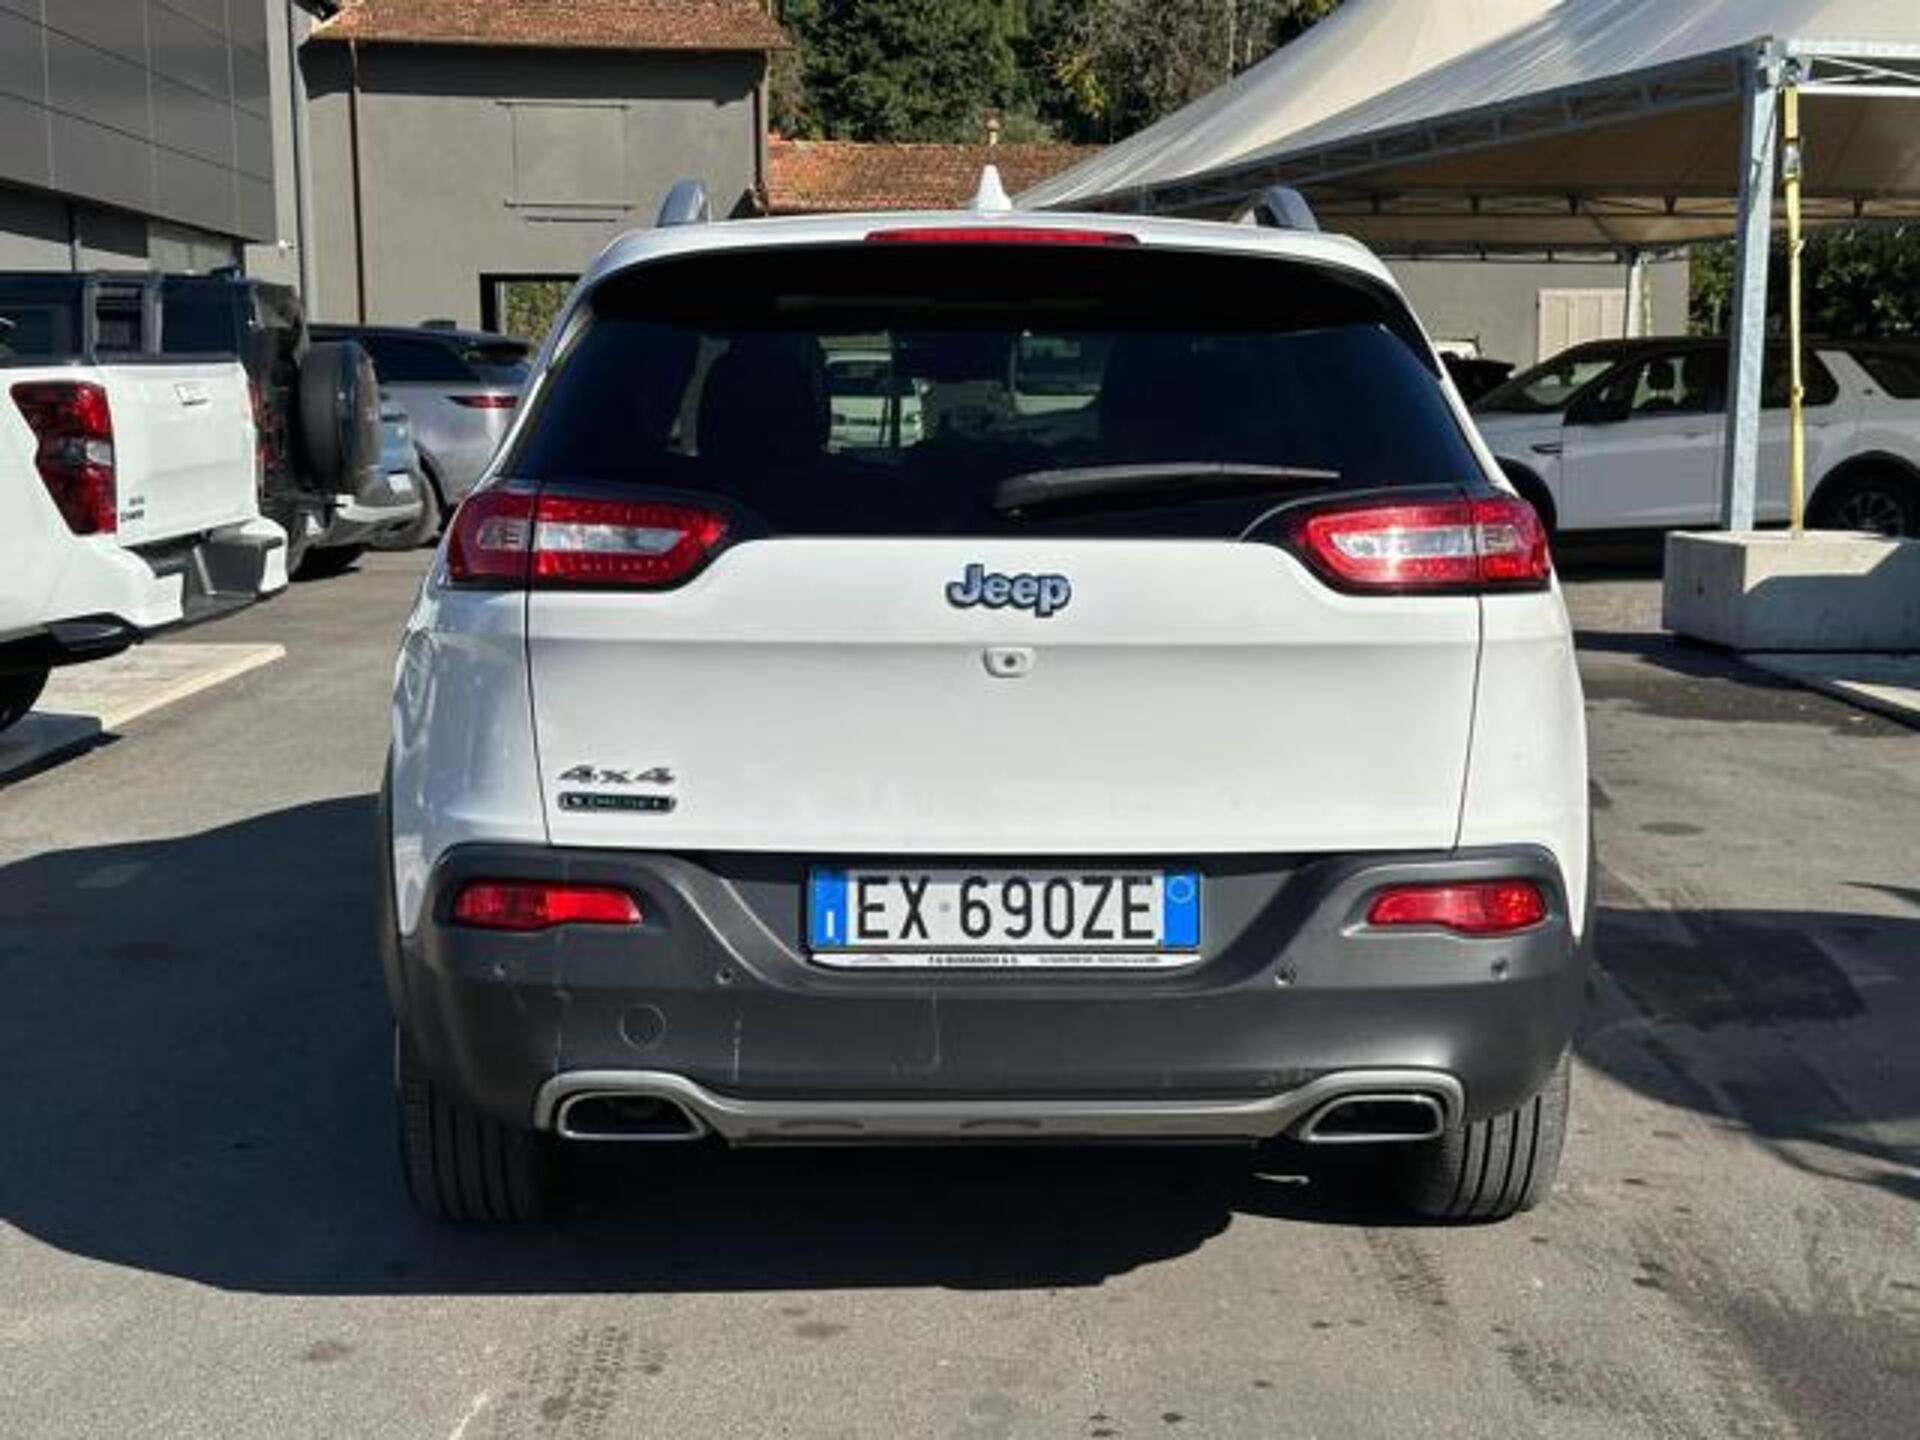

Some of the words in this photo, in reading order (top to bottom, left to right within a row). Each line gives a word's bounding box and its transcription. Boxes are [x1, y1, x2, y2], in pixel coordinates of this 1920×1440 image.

[946, 563, 1071, 618] Jeep
[557, 764, 675, 785] 4x4
[857, 875, 930, 940] EX
[958, 875, 1155, 940] 690ZE
